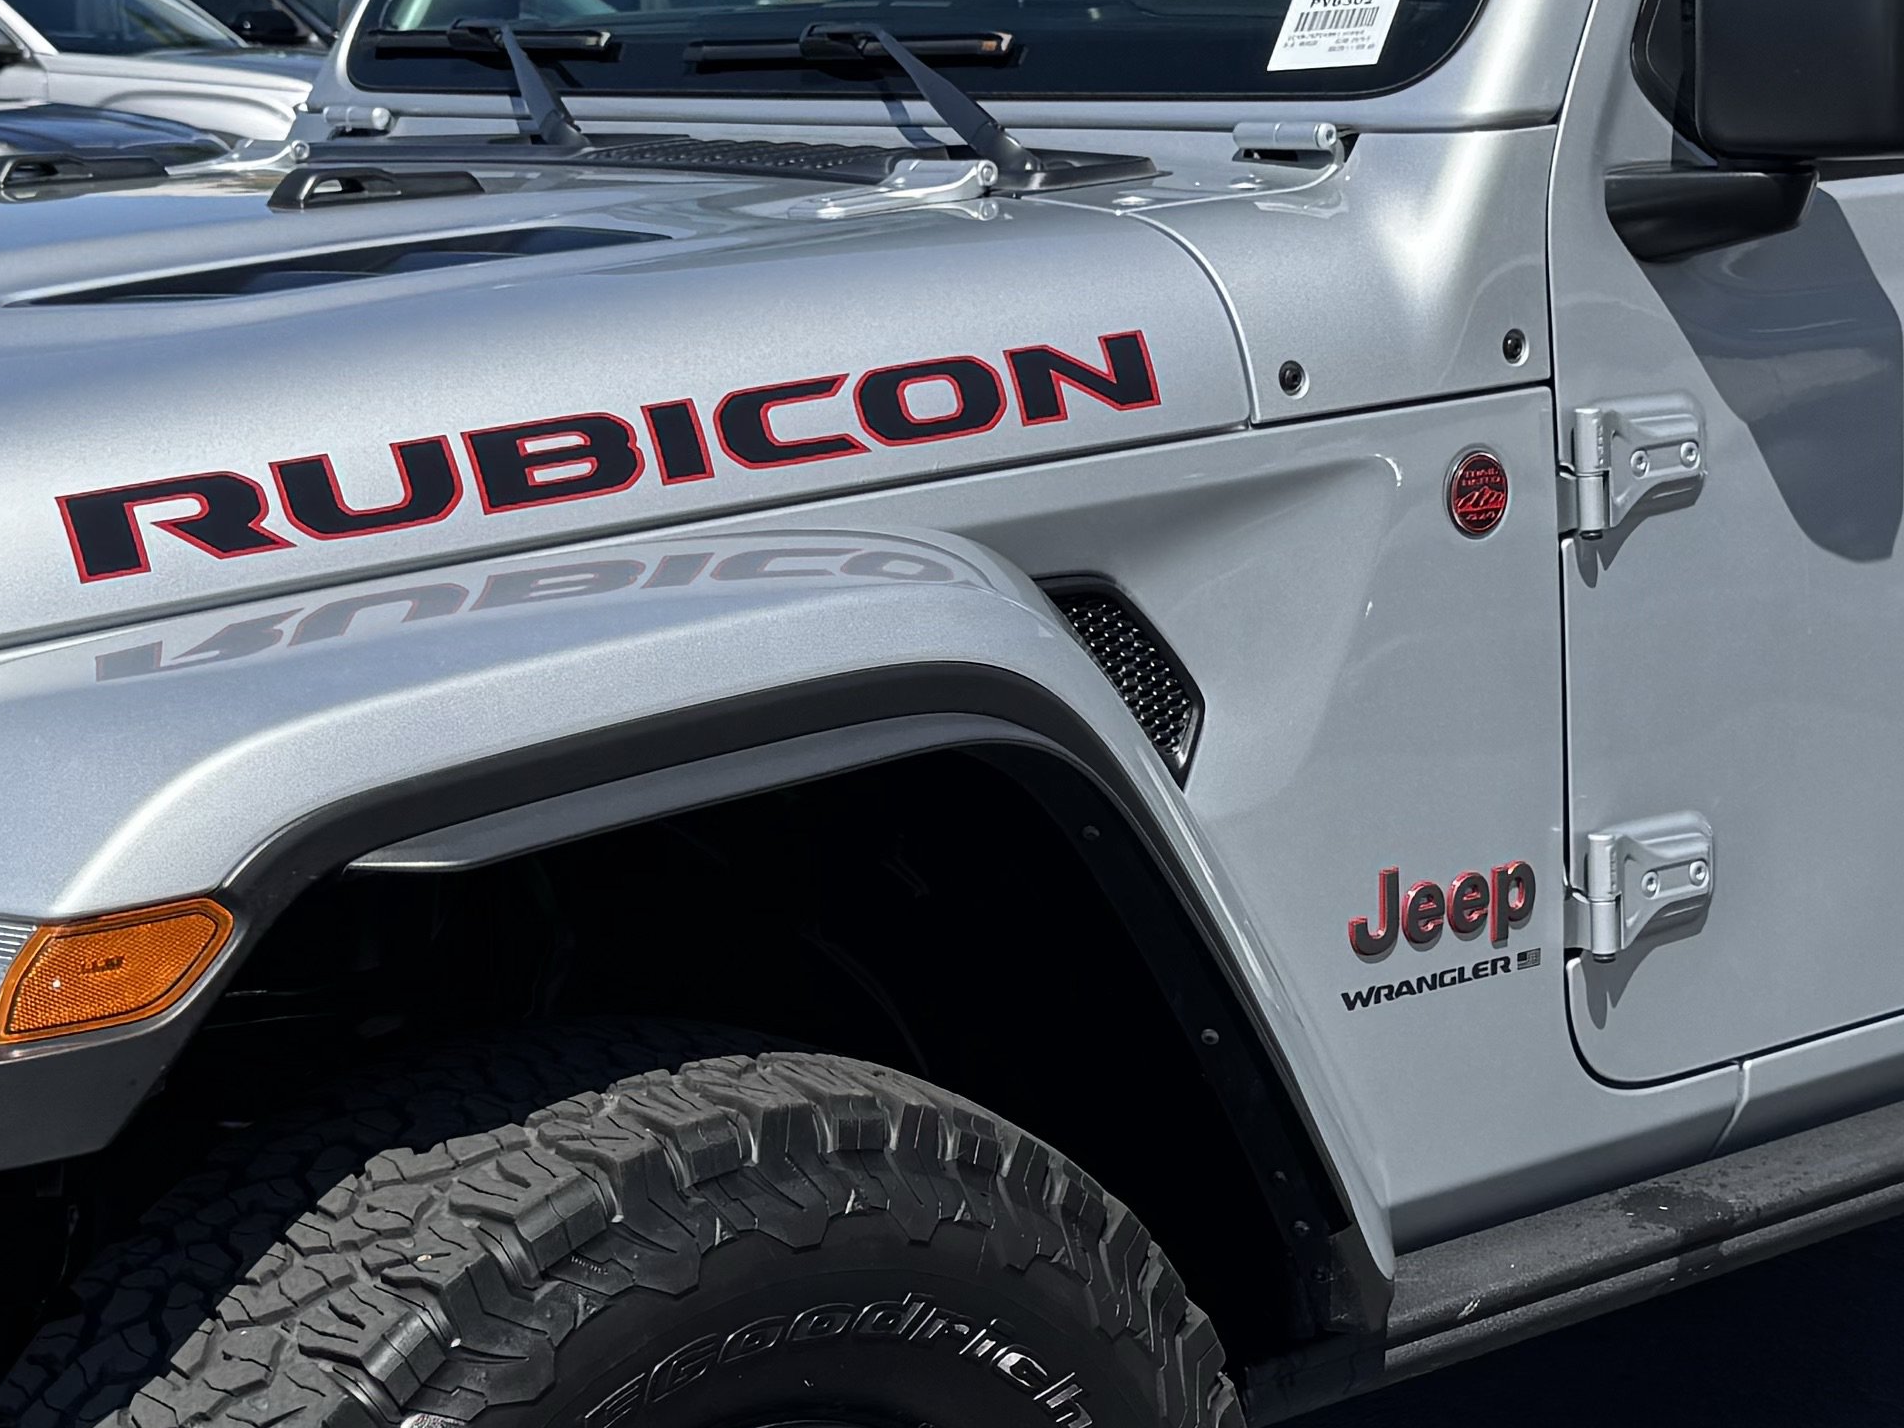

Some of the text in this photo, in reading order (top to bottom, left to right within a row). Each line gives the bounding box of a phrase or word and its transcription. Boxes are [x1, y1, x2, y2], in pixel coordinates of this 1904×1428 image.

[54, 329, 1163, 585] RUBICON
[1347, 859, 1537, 957] Jeep
[1340, 955, 1512, 1012] WRANGLER
